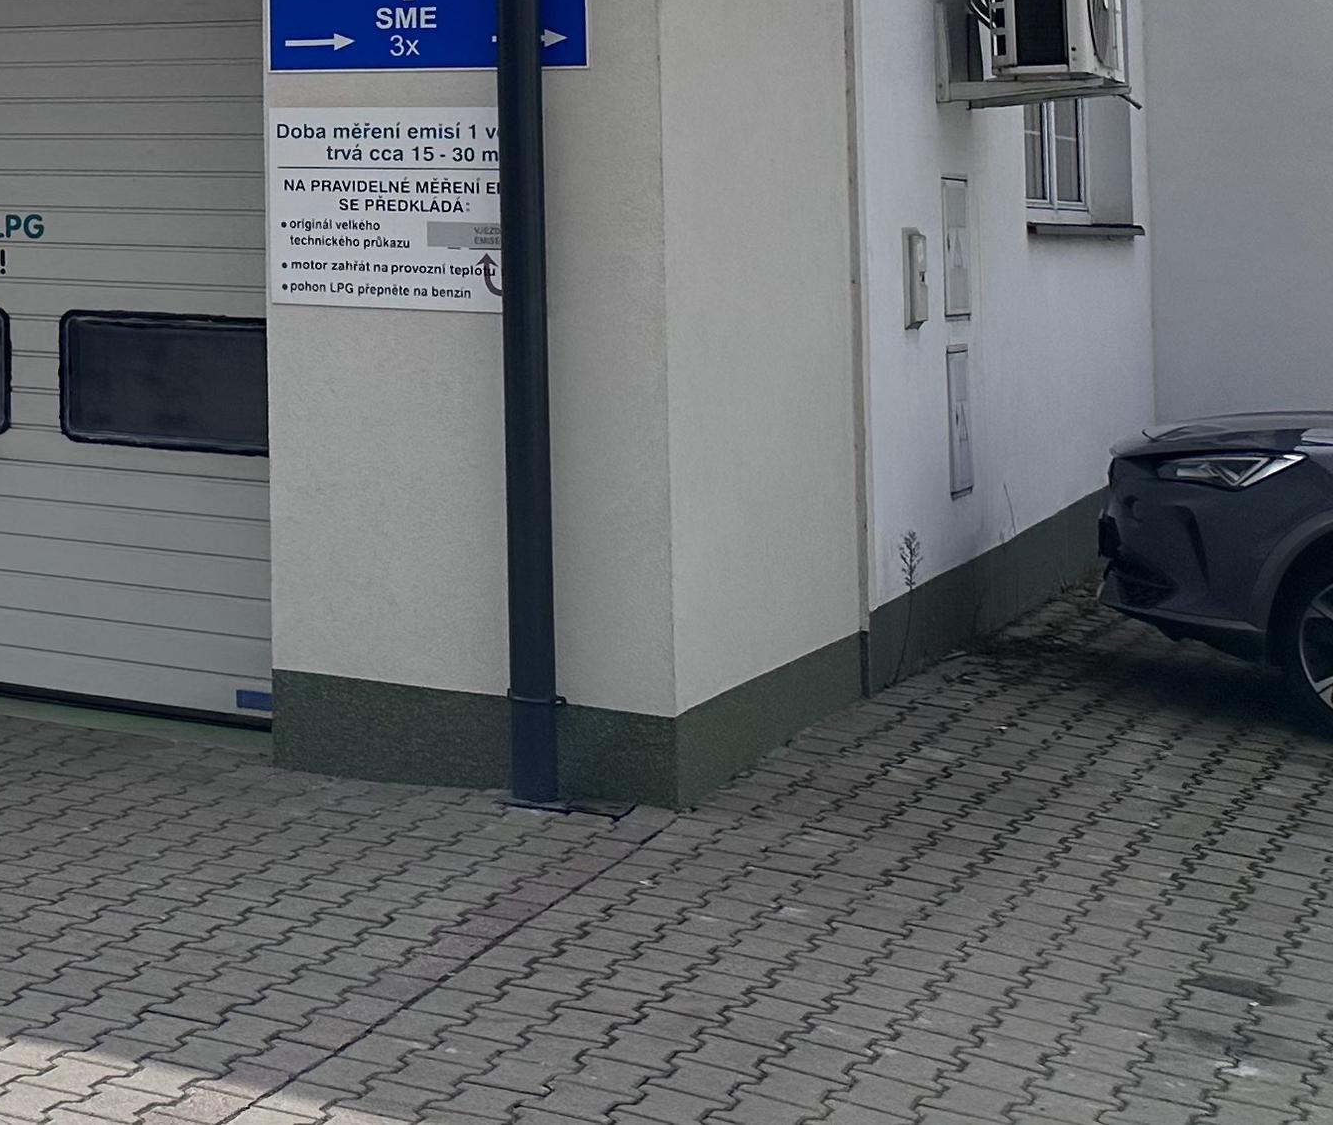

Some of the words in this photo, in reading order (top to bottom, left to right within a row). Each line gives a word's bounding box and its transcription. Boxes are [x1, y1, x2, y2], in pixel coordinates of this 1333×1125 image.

[375, 6, 438, 30] SME
[389, 34, 421, 57] 3x
[276, 123, 326, 140] Doba
[332, 122, 401, 140] měření
[407, 122, 461, 140] emisí
[468, 124, 477, 139] 1
[326, 144, 363, 161] trvá
[369, 147, 404, 162] cca
[411, 146, 435, 162] 15
[452, 147, 475, 162] 30
[283, 179, 306, 192] NA
[310, 177, 411, 193] PRAVIDELNÉ
[415, 177, 481, 195] MĚŘENÍ
[338, 197, 360, 212] SE
[364, 195, 471, 213] PŘEDKLÁDÁ:
[289, 218, 333, 232] originál
[335, 219, 381, 231] velkého
[289, 235, 360, 247] technického
[362, 235, 411, 250] průkazu
[0, 248, 7, 275] !
[290, 260, 328, 271] motor
[331, 260, 371, 272] zahřát
[373, 263, 389, 273] na
[390, 263, 447, 277] provozní
[289, 282, 327, 294] pohon
[329, 283, 354, 294] LPG
[357, 283, 410, 298] přepněte
[413, 287, 429, 297] na
